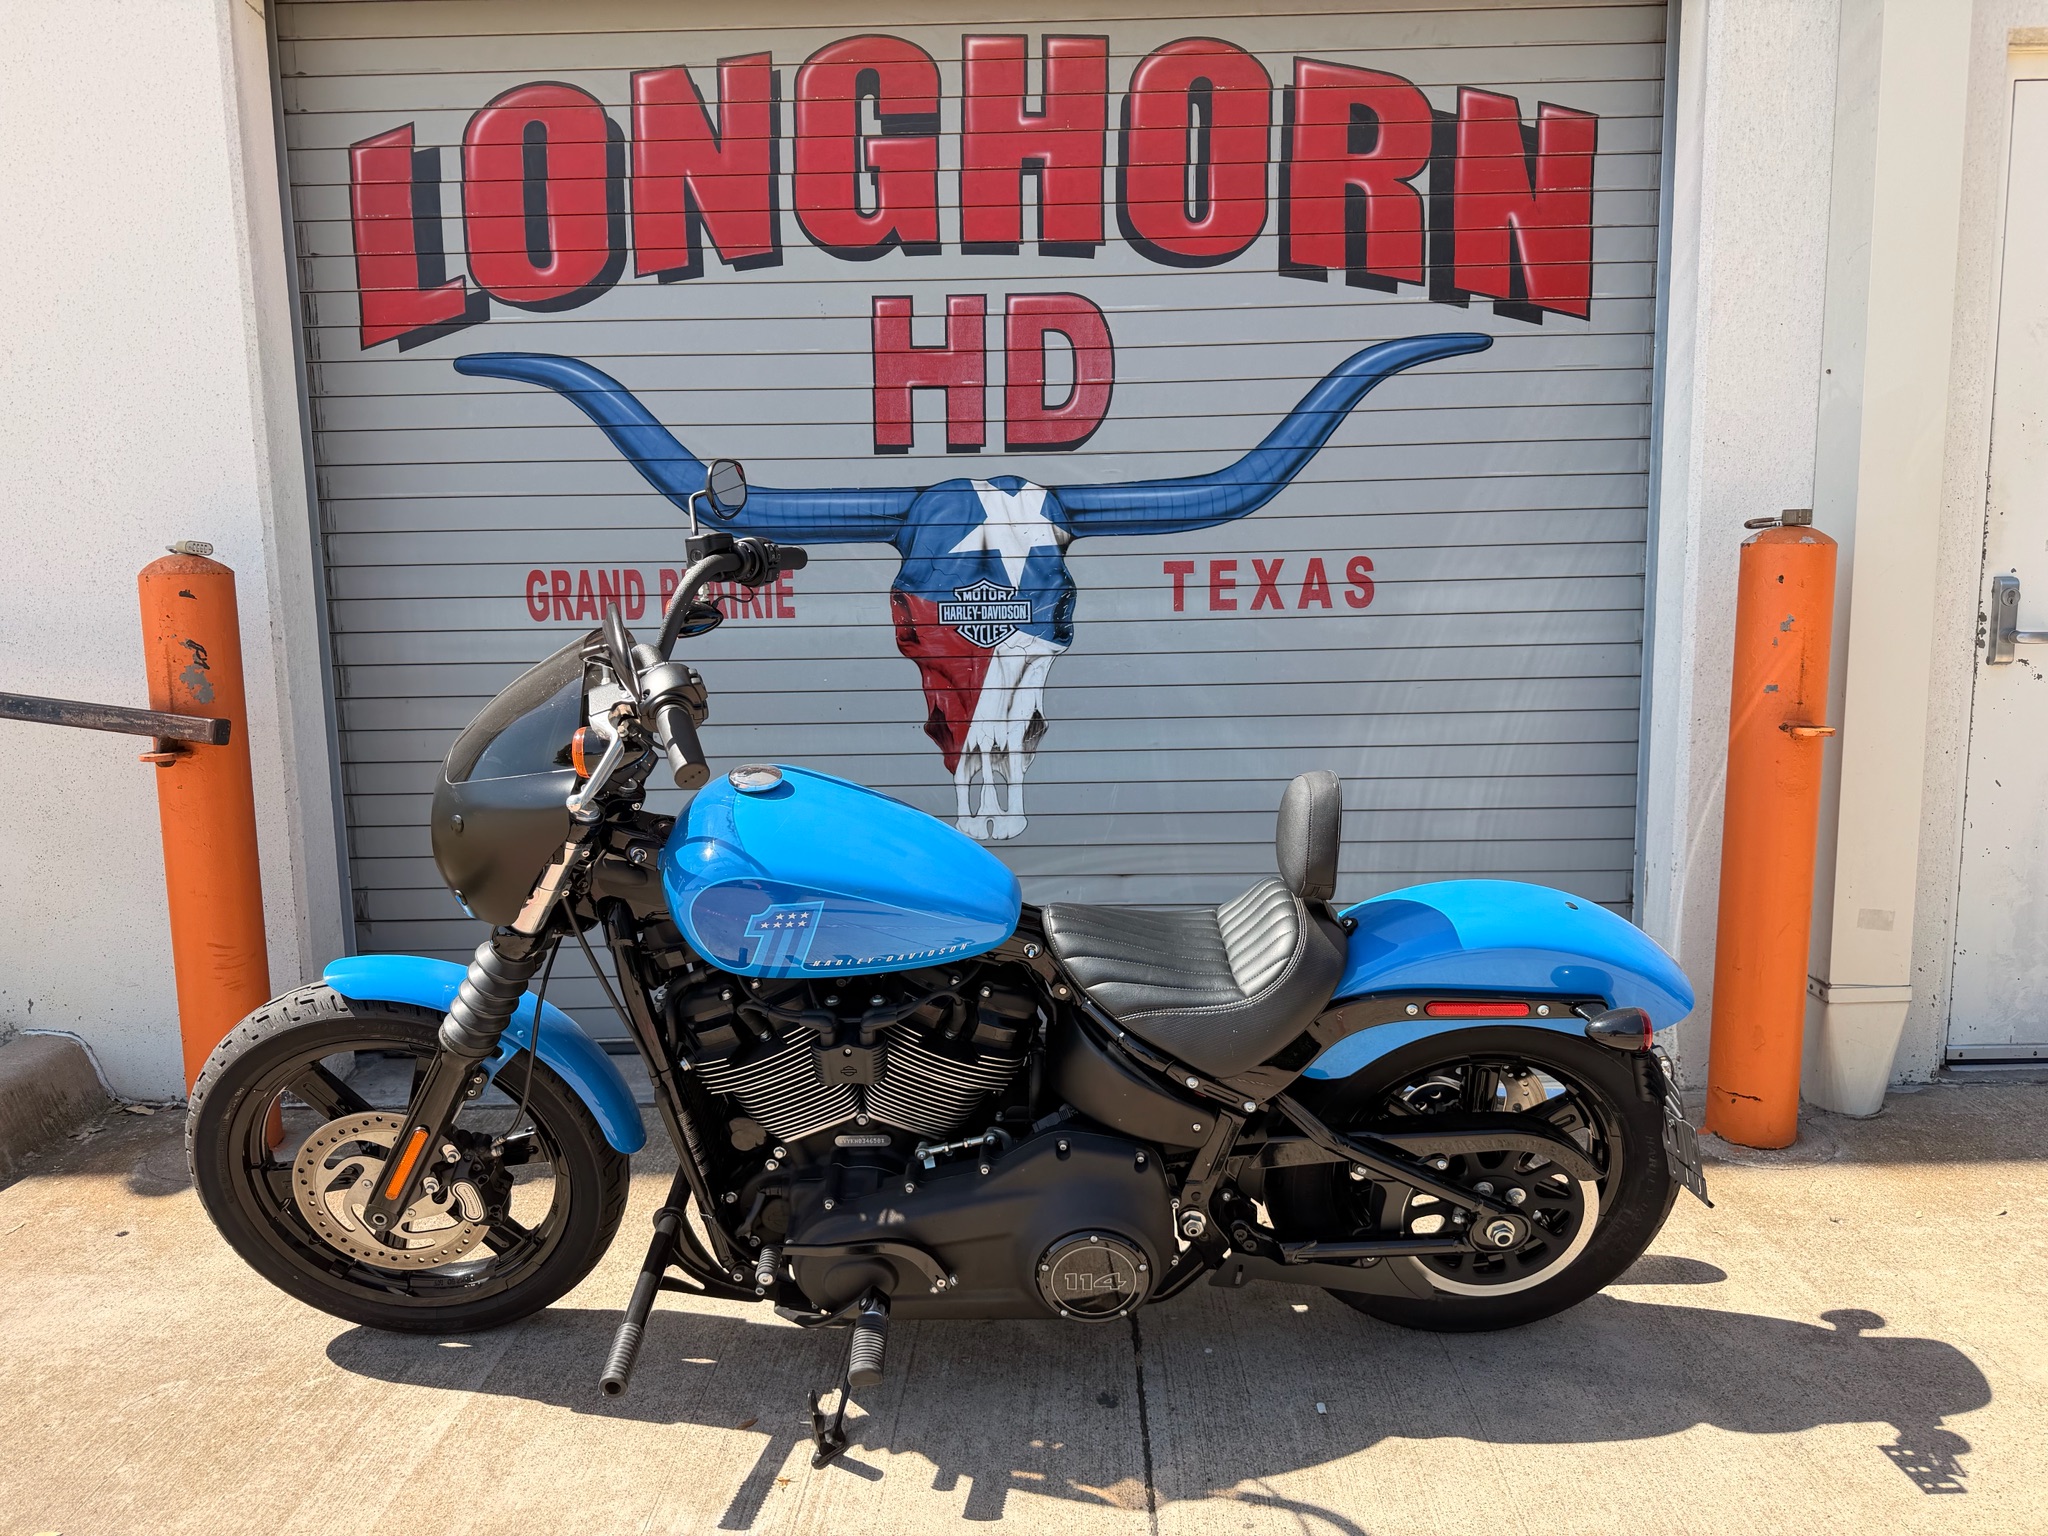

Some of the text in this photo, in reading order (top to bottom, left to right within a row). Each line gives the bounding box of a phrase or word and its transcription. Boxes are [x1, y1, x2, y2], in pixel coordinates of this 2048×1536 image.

[350, 34, 1598, 352] LONGHORN
[872, 292, 1114, 454] HD
[526, 568, 796, 622] GRAND PAIRIE
[962, 584, 1007, 602] MOTOR
[1163, 556, 1375, 612] TEXAS
[943, 604, 1027, 620] HARLEY-DAVIDSON
[964, 624, 1008, 645] CYCLES
[812, 943, 969, 967] HARLEY-DAVIDSON
[1064, 1272, 1127, 1291] 114
